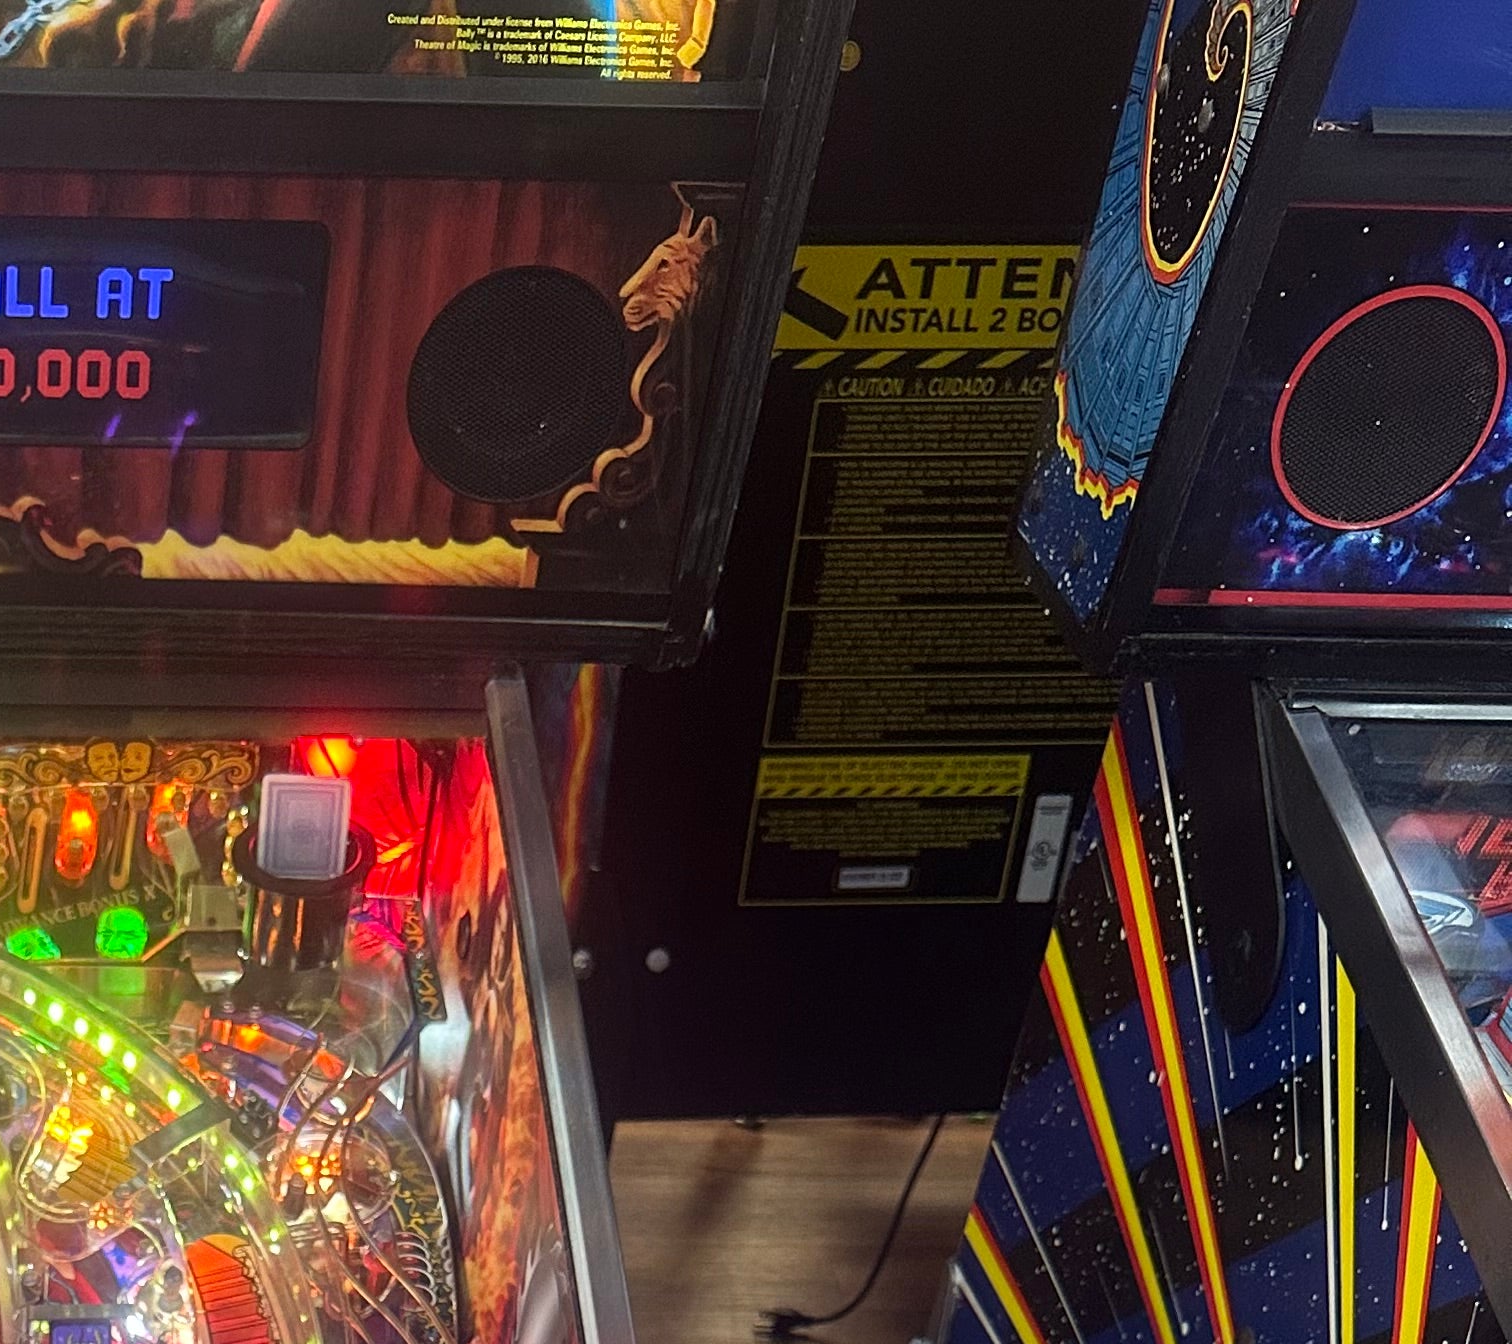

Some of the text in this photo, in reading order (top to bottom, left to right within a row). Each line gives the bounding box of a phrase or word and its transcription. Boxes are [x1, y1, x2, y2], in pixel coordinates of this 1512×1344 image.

[95, 267, 173, 320] AT
[854, 307, 978, 333] INSTALL
[989, 307, 1007, 333] 2
[839, 376, 904, 397] CAUTION
